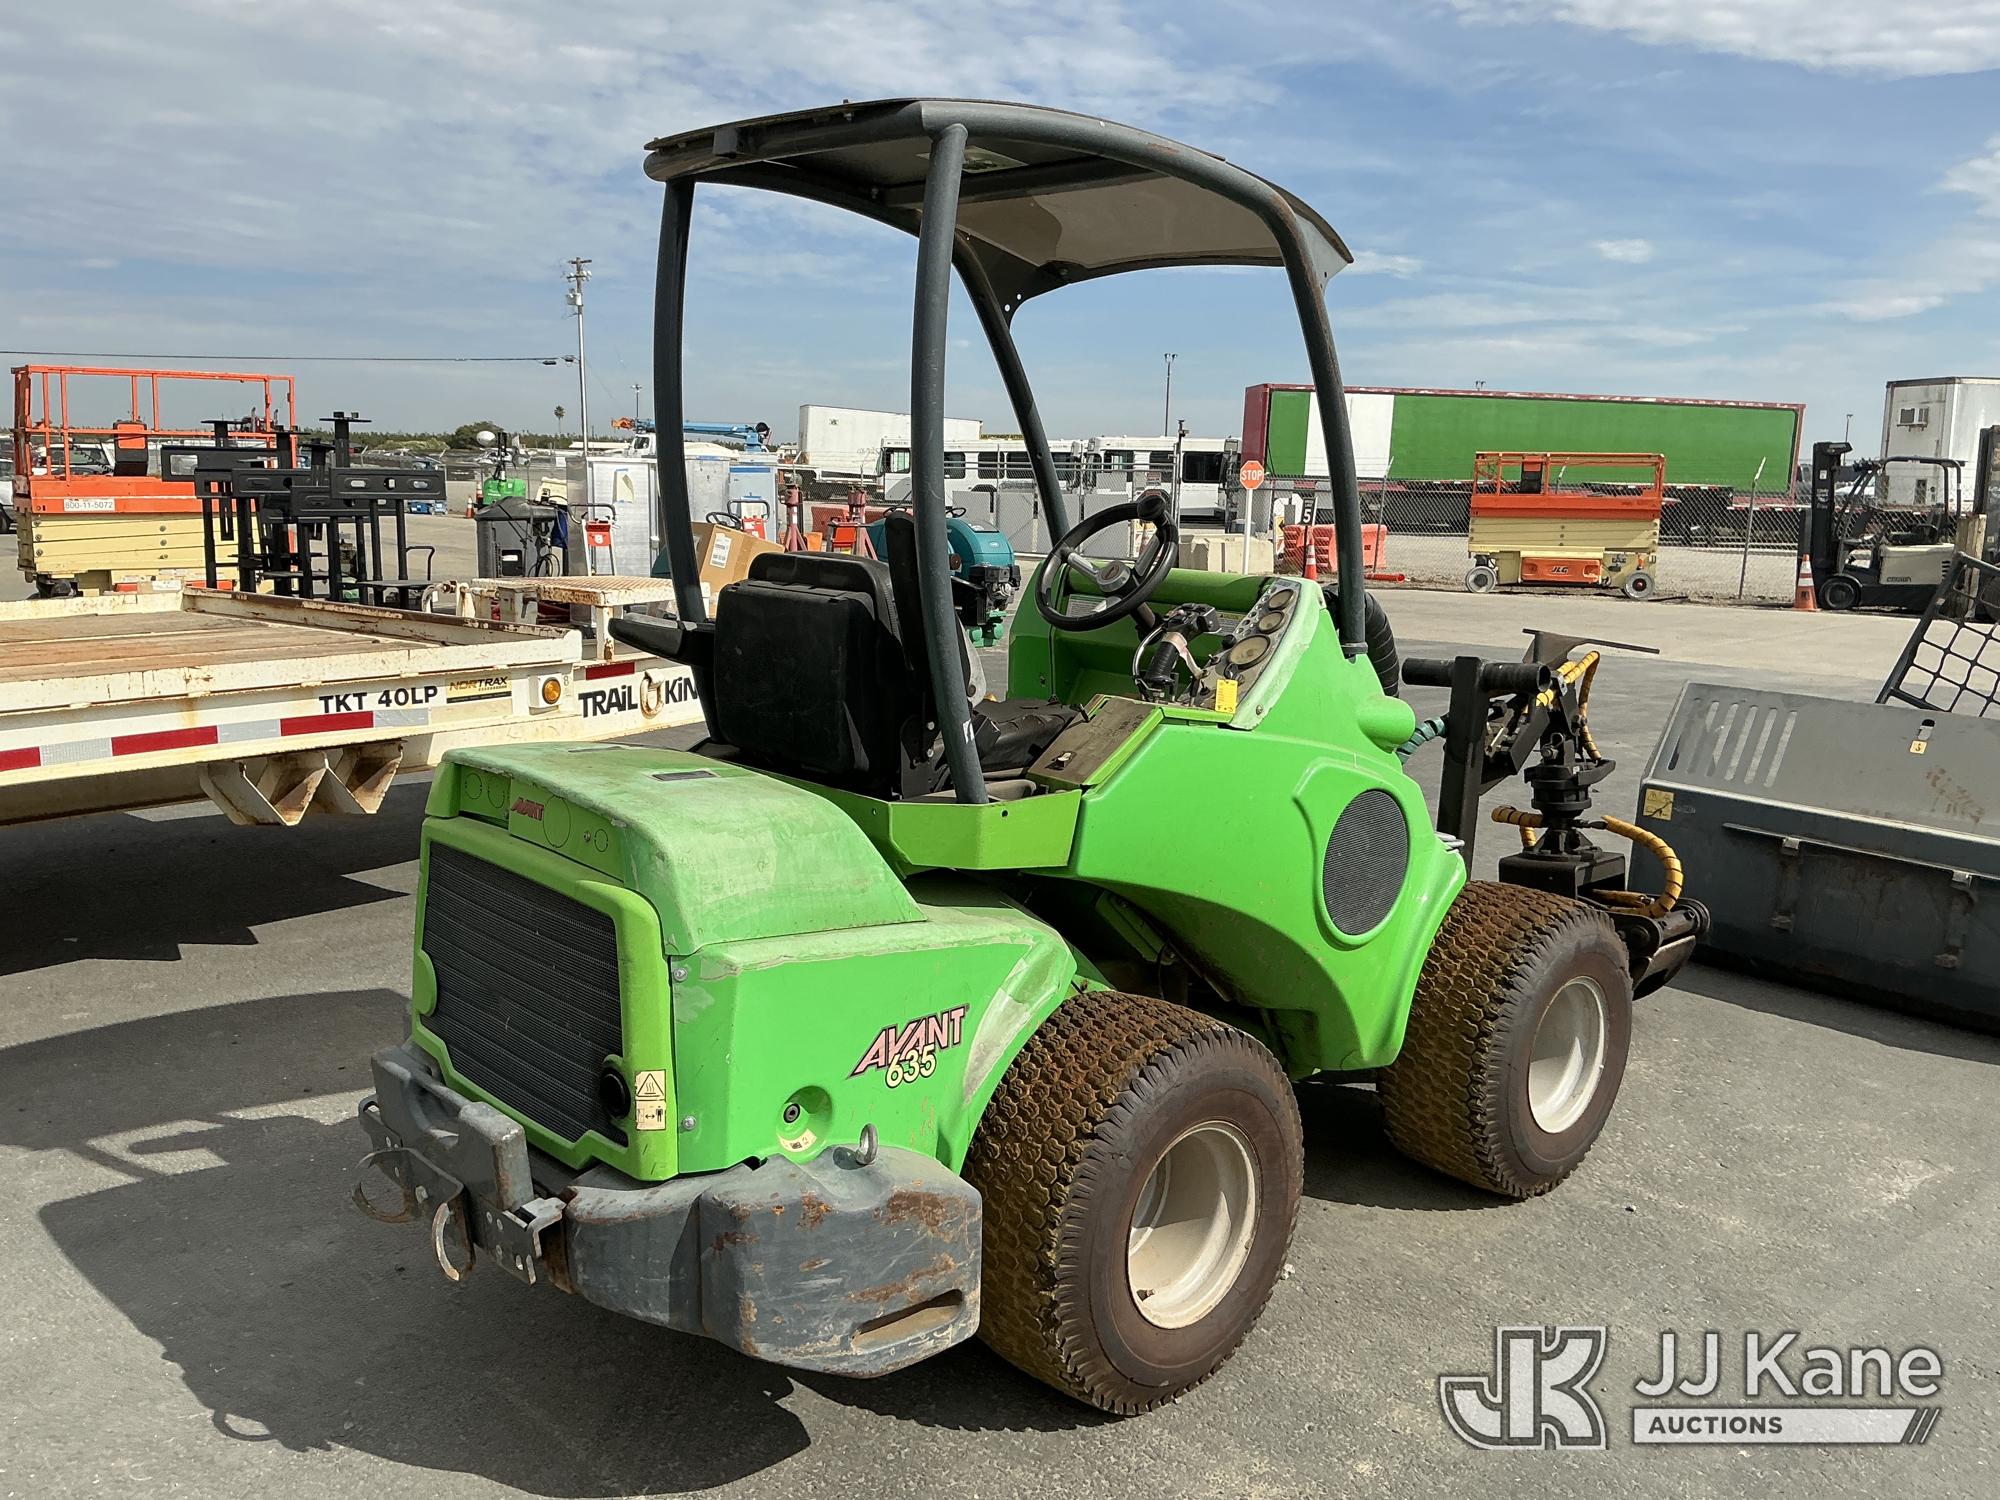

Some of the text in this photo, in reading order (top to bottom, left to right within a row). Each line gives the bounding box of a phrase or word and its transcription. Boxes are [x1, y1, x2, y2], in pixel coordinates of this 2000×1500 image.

[1241, 469, 1263, 481] STOP
[1303, 508, 1312, 523] 5
[1551, 565, 1569, 574] JLG
[449, 676, 508, 691] NORTRAX
[318, 685, 438, 714] TKT 40LP
[848, 1004, 967, 1077] AVANT
[885, 1043, 938, 1089] 635
